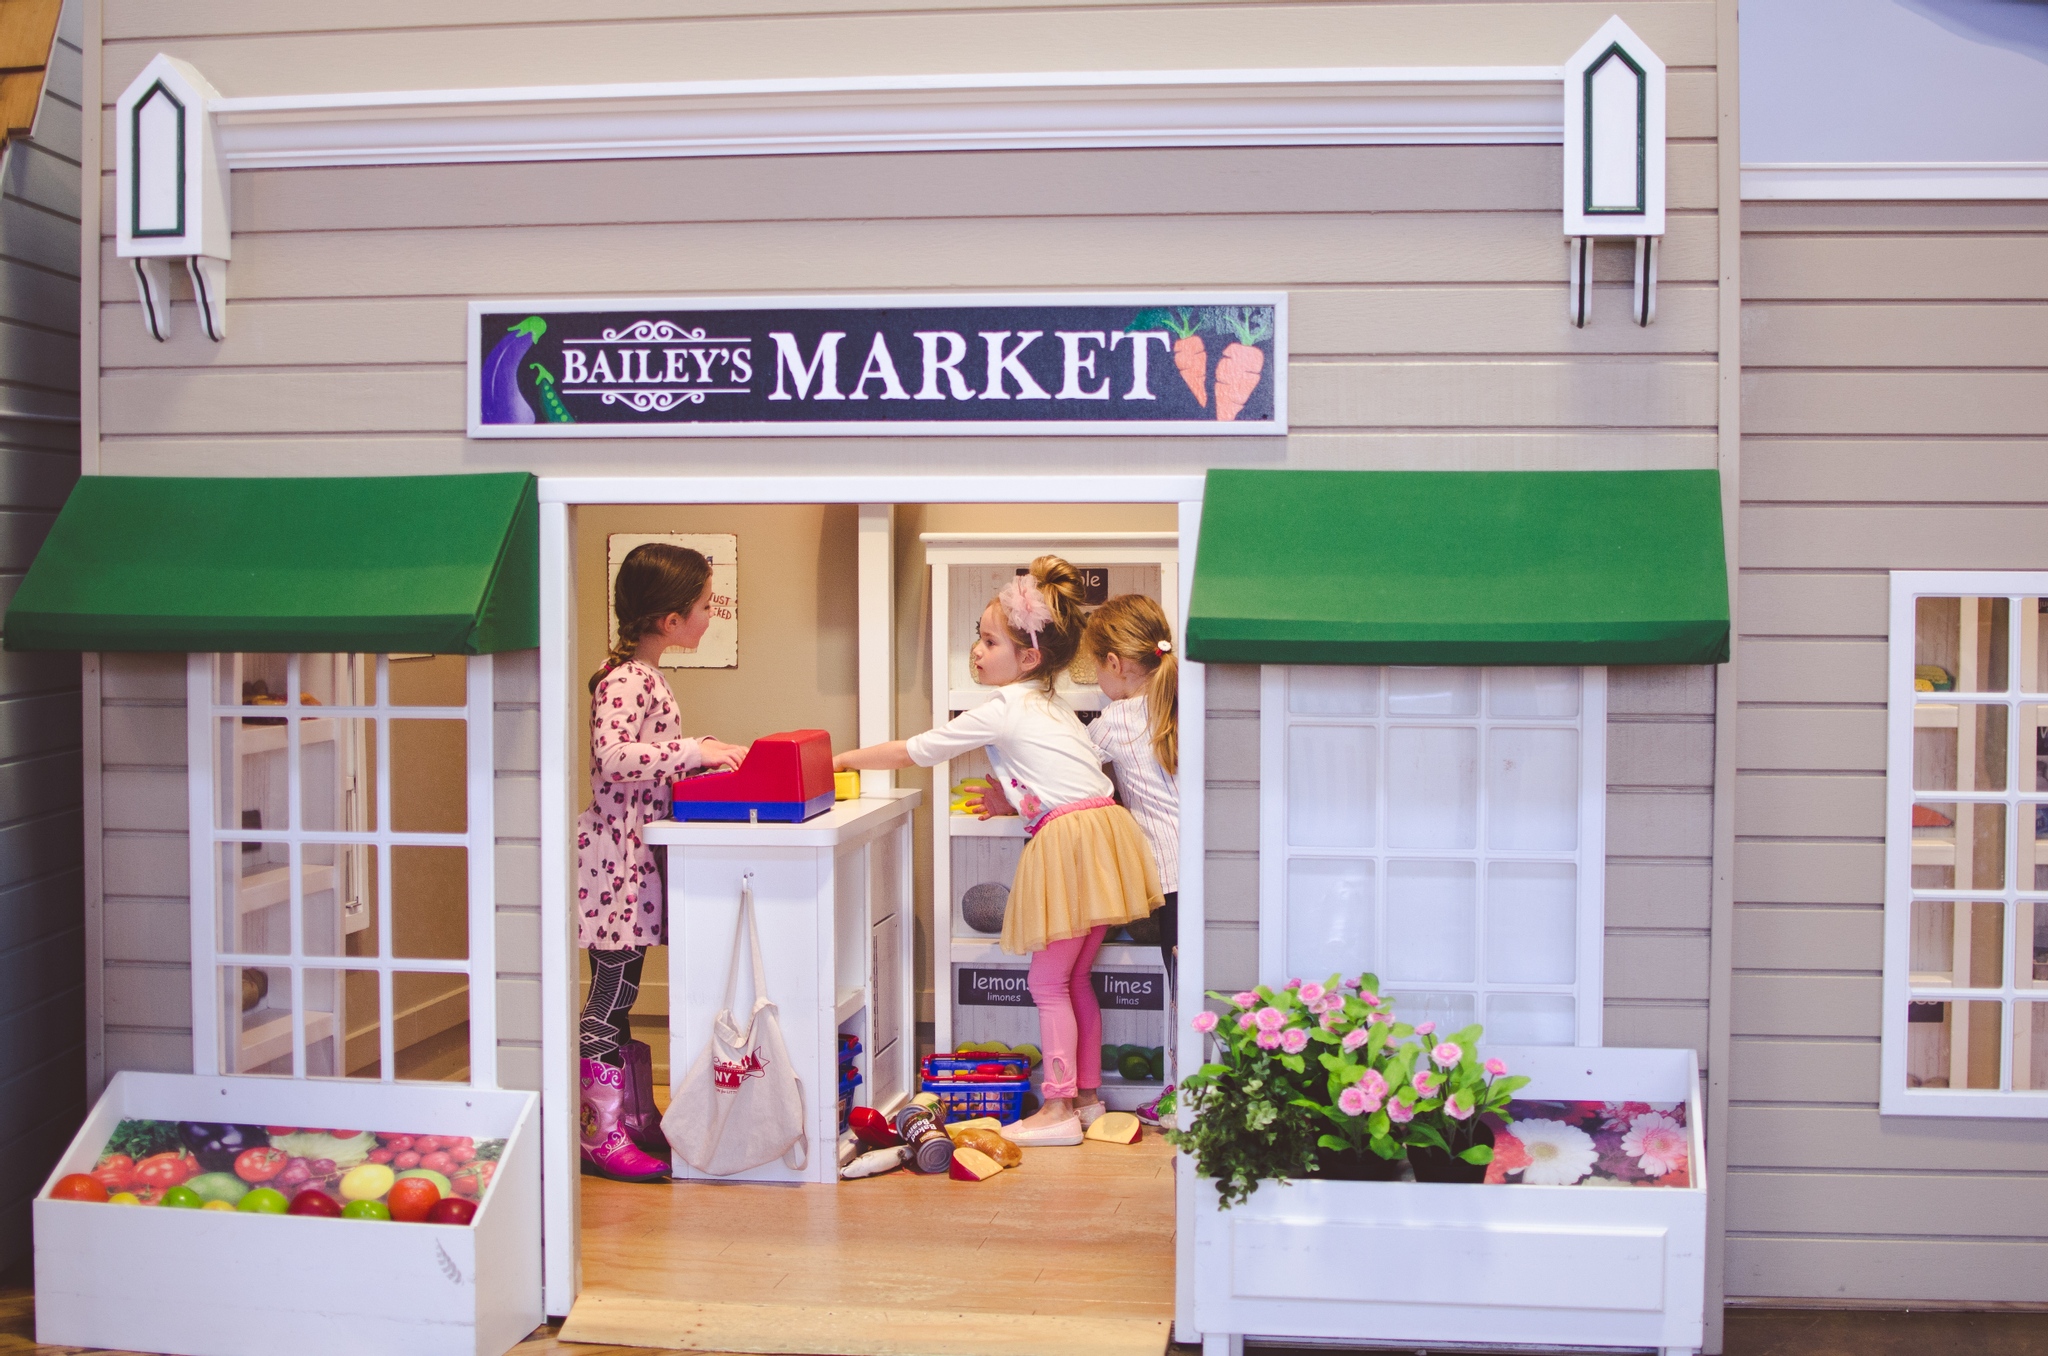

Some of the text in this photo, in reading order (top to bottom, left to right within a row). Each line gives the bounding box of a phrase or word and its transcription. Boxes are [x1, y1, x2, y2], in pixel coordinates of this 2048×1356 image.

[562, 331, 1171, 401] BAILEY'S MARKET
[713, 607, 732, 620] KED
[972, 971, 1029, 991] lemon
[1104, 974, 1153, 995] limes
[987, 991, 1022, 1003] limones
[1115, 994, 1141, 1006] limas
[906, 1118, 930, 1138] Beans
[910, 1123, 937, 1142] Baked
